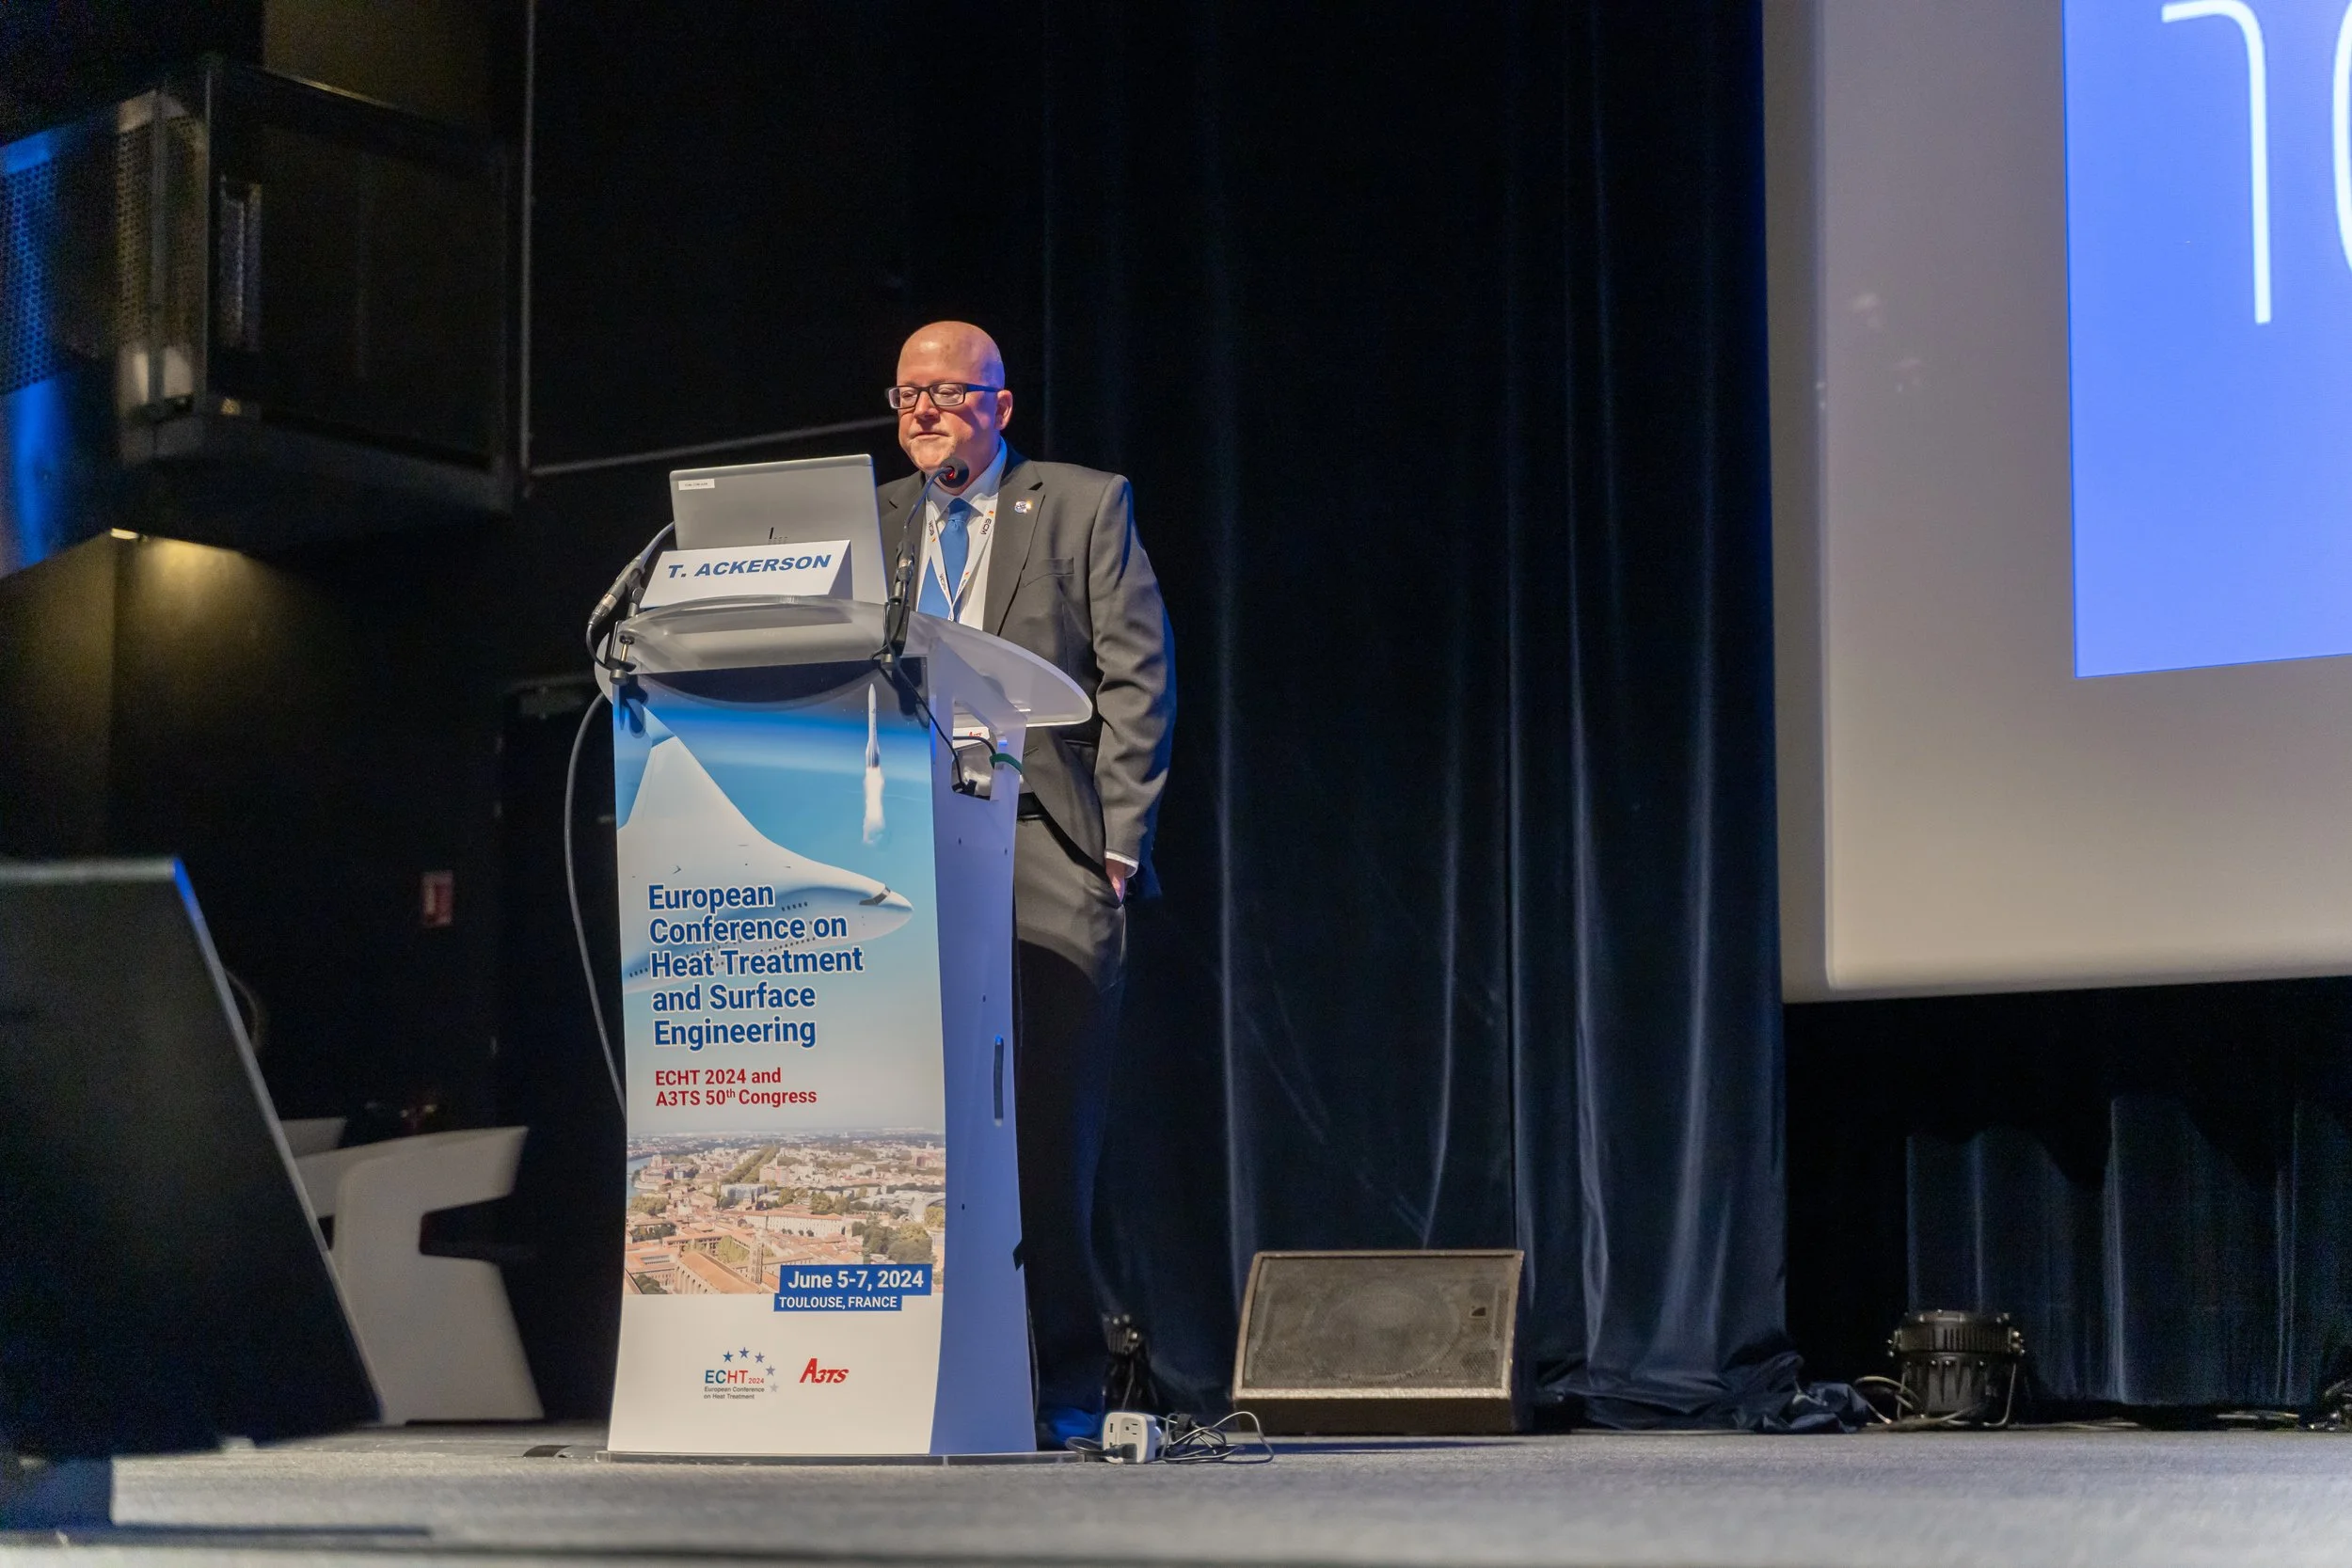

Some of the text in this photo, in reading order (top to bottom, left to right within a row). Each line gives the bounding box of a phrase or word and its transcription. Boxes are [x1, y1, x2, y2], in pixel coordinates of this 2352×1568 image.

[980, 517, 993, 536] ECM
[668, 554, 832, 578] T. ACKERSON
[648, 884, 774, 914] European
[649, 915, 848, 944] Conference on
[651, 947, 864, 978] Heat Treatment
[652, 982, 816, 1012] and Surface
[654, 1016, 816, 1051] Engineering
[655, 1067, 781, 1085] ECHT 2024 and
[656, 1088, 818, 1108] A3TS 50th Congress
[787, 1270, 924, 1291] June 5-7, 2024
[779, 1296, 898, 1309] TOULOUSE, FRANCE
[705, 1370, 748, 1384] ECHT
[800, 1357, 849, 1384] A3TS
